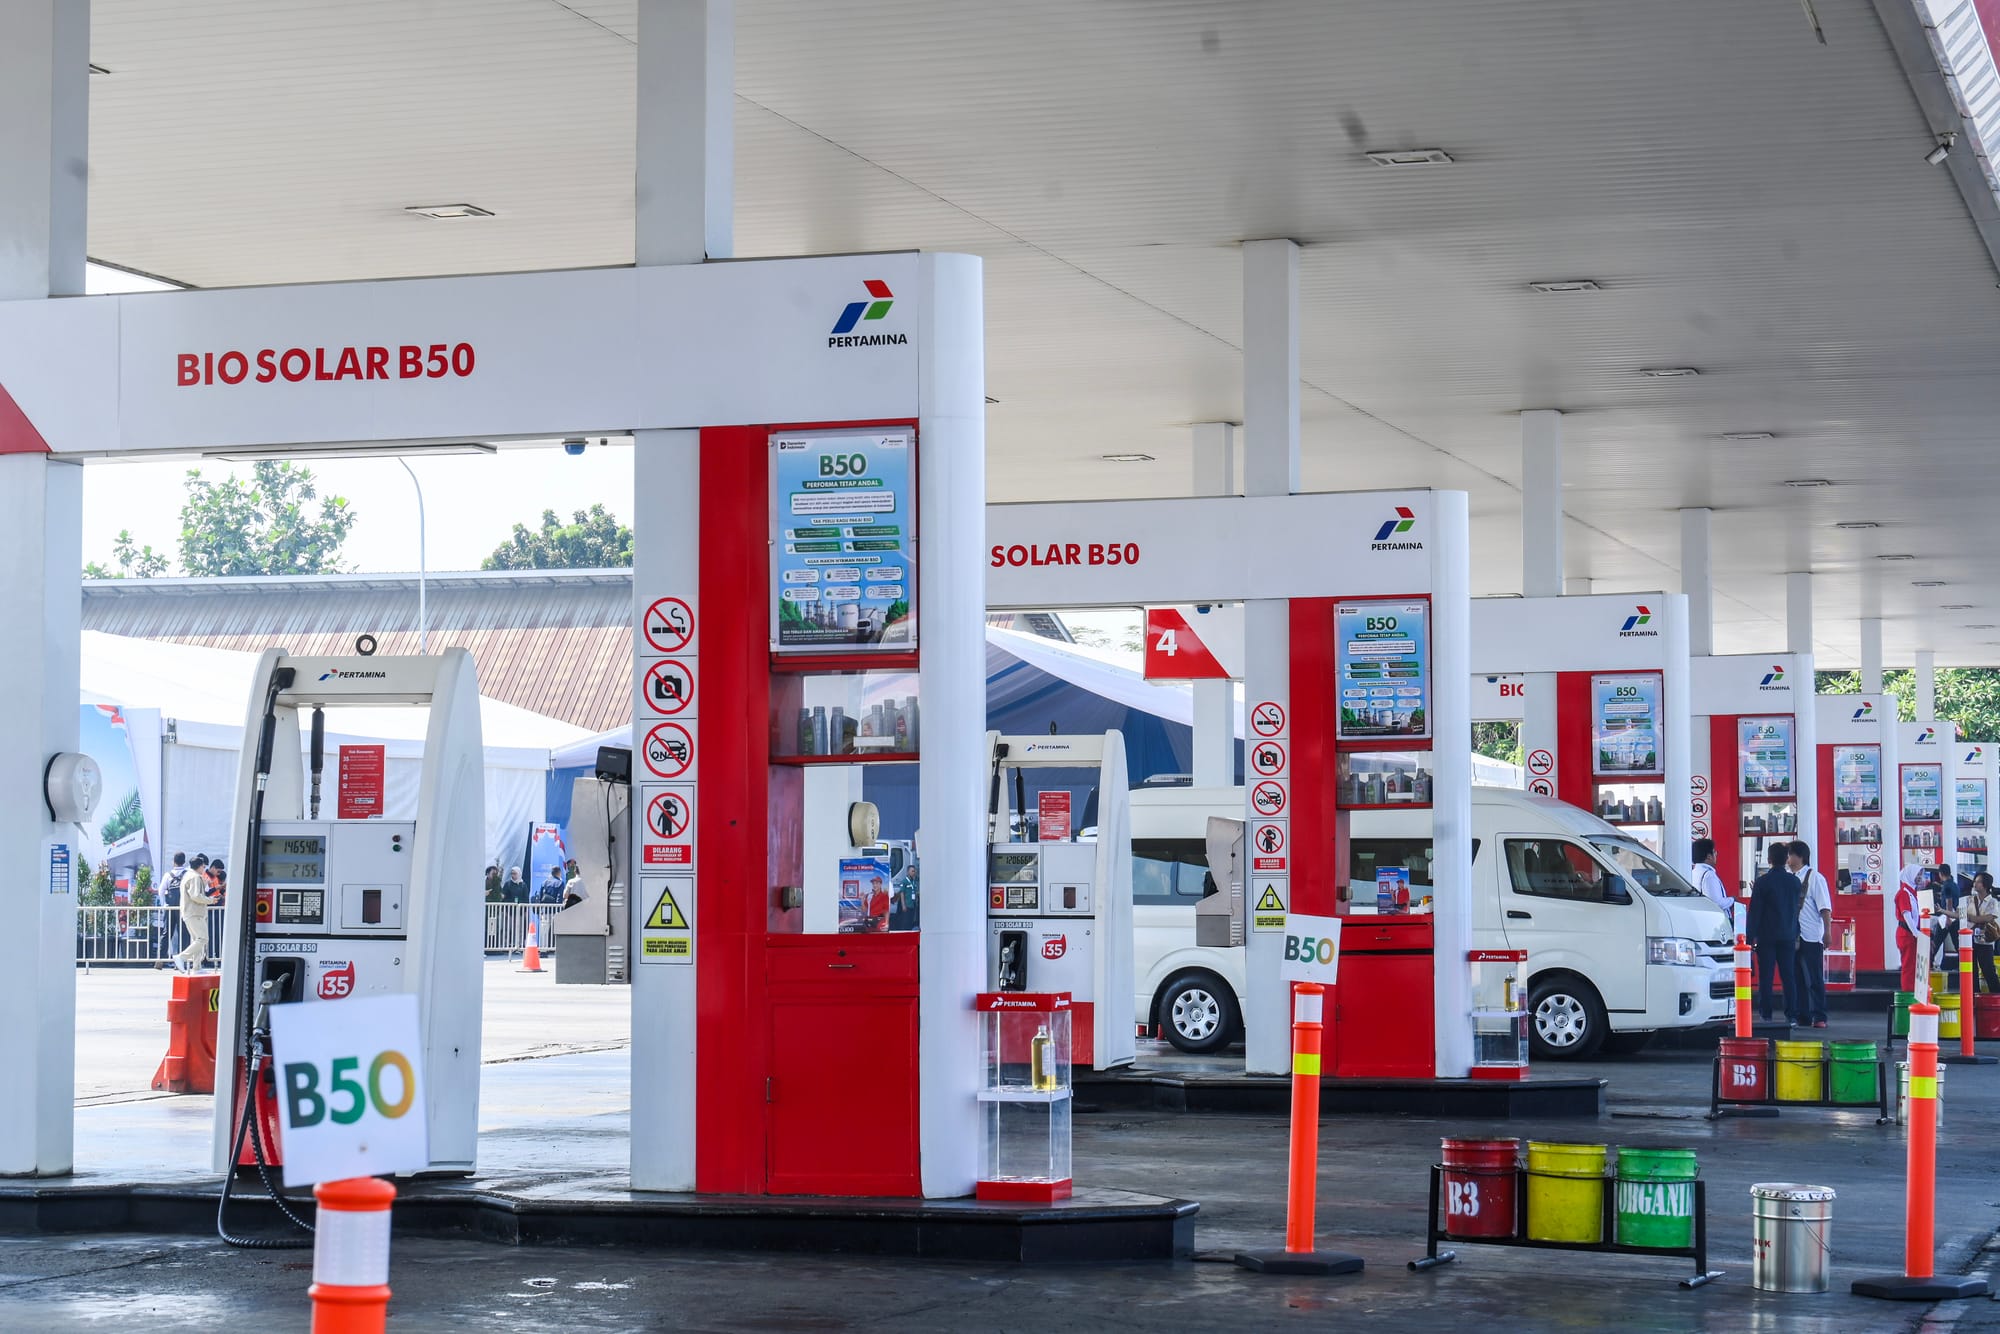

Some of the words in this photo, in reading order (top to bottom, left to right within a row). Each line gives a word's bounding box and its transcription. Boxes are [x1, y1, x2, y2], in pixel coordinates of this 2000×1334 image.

[828, 333, 908, 348] PERTAMINA
[177, 350, 249, 387] BIO
[255, 346, 390, 383] SOLAR
[399, 342, 475, 379] B50
[819, 453, 867, 477] B50
[806, 481, 838, 489] PERFORMA
[857, 479, 879, 487] ANDAL
[990, 543, 1082, 568] SOLAR
[1088, 542, 1140, 566] B50
[1371, 542, 1423, 551] PERTAMINA
[1366, 617, 1397, 631] B50
[1155, 628, 1179, 657] 4
[1619, 630, 1658, 638] PERTAMINA
[338, 671, 386, 679] PERTAMINA
[1616, 686, 1637, 697] B50
[261, 944, 275, 952] BIO
[276, 944, 301, 952] SOLAR
[302, 944, 317, 952] B50
[1042, 943, 1064, 957] 135
[1285, 935, 1335, 965] B50
[319, 975, 350, 996] 135
[1732, 1064, 1757, 1087] B3
[284, 1049, 415, 1129] B50
[1448, 1181, 1480, 1217] B3
